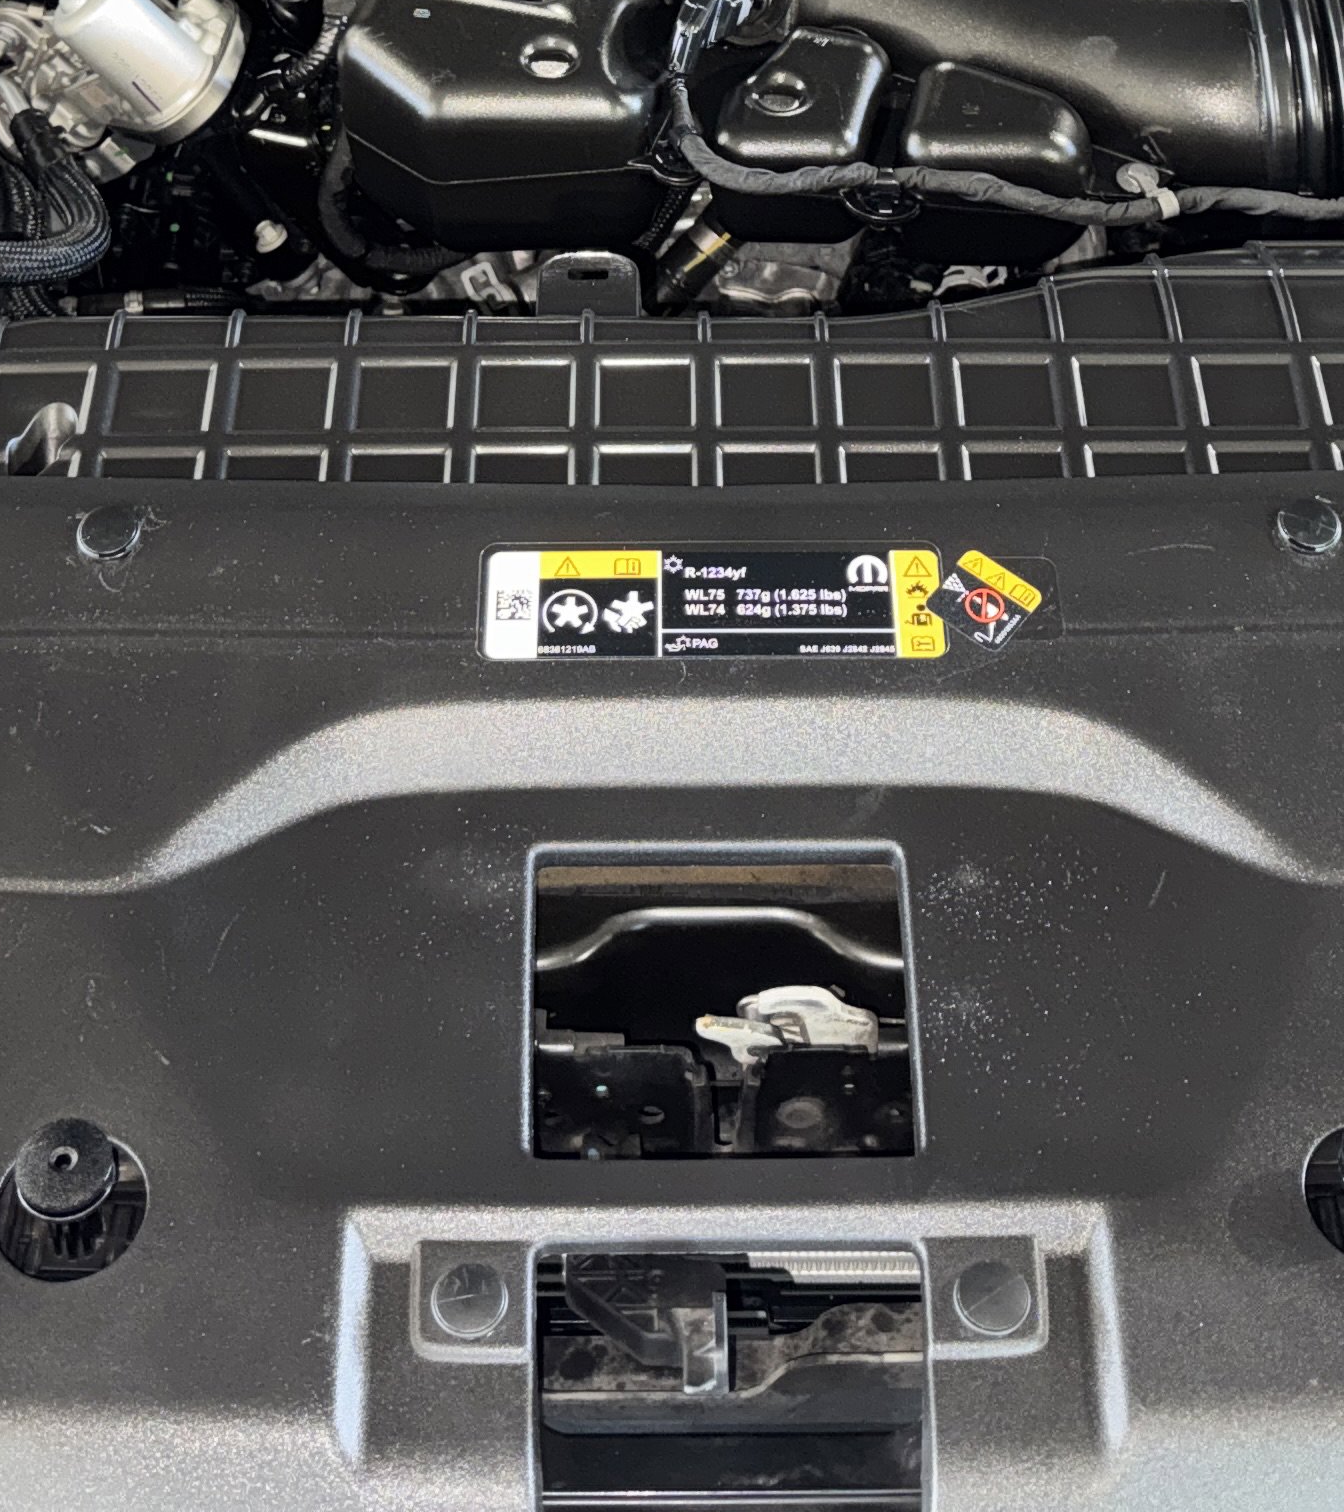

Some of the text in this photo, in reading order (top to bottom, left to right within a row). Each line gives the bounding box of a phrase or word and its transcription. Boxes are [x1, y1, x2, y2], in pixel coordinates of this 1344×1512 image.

[684, 566, 747, 581] R-1234yf
[684, 589, 846, 603] WL75 737g (1.625 lbs)
[684, 603, 847, 617] WL74 624g (1.375 lbs)
[692, 638, 719, 649] PAG
[799, 644, 819, 654] SAE
